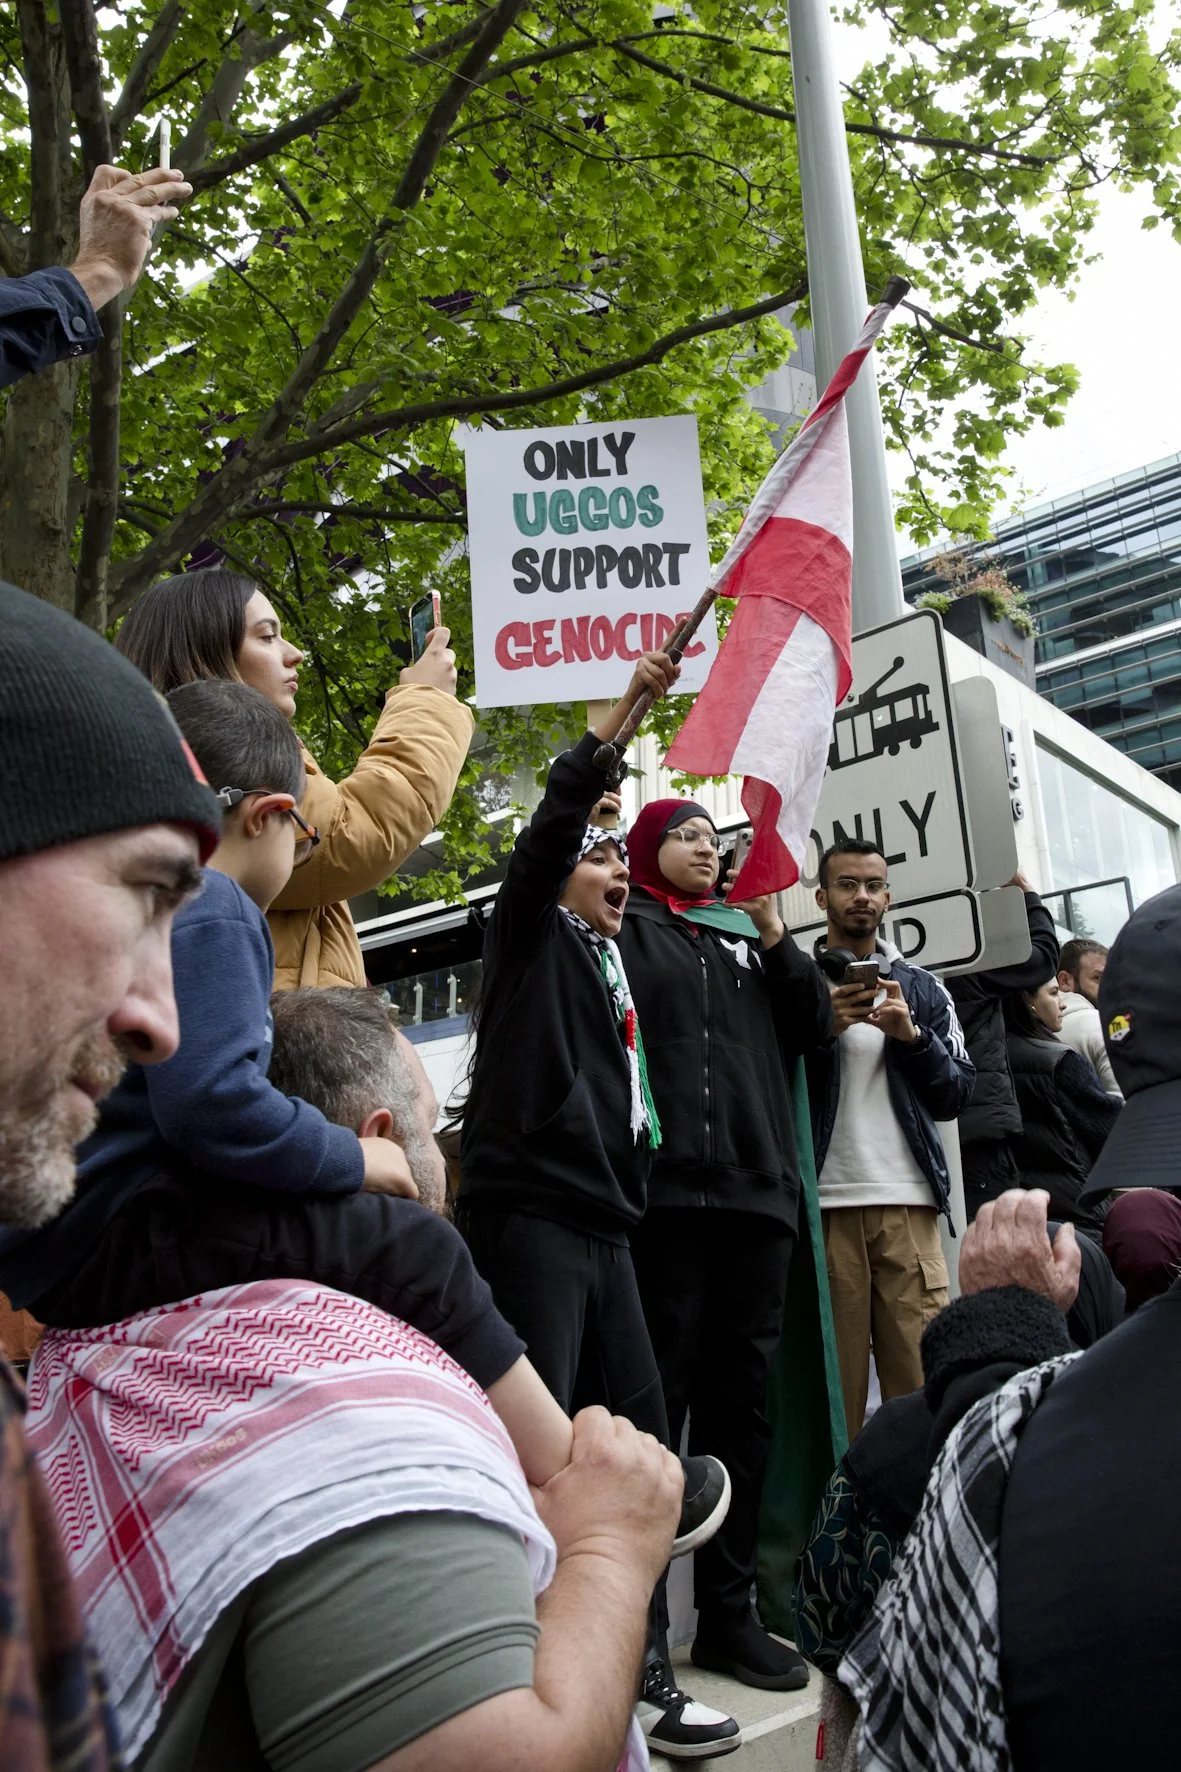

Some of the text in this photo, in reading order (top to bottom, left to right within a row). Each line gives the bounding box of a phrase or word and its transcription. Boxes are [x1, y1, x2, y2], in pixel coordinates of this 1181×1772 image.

[523, 431, 636, 481] ONLY
[513, 484, 664, 537] UGGOS
[511, 542, 691, 595] SUPPORT
